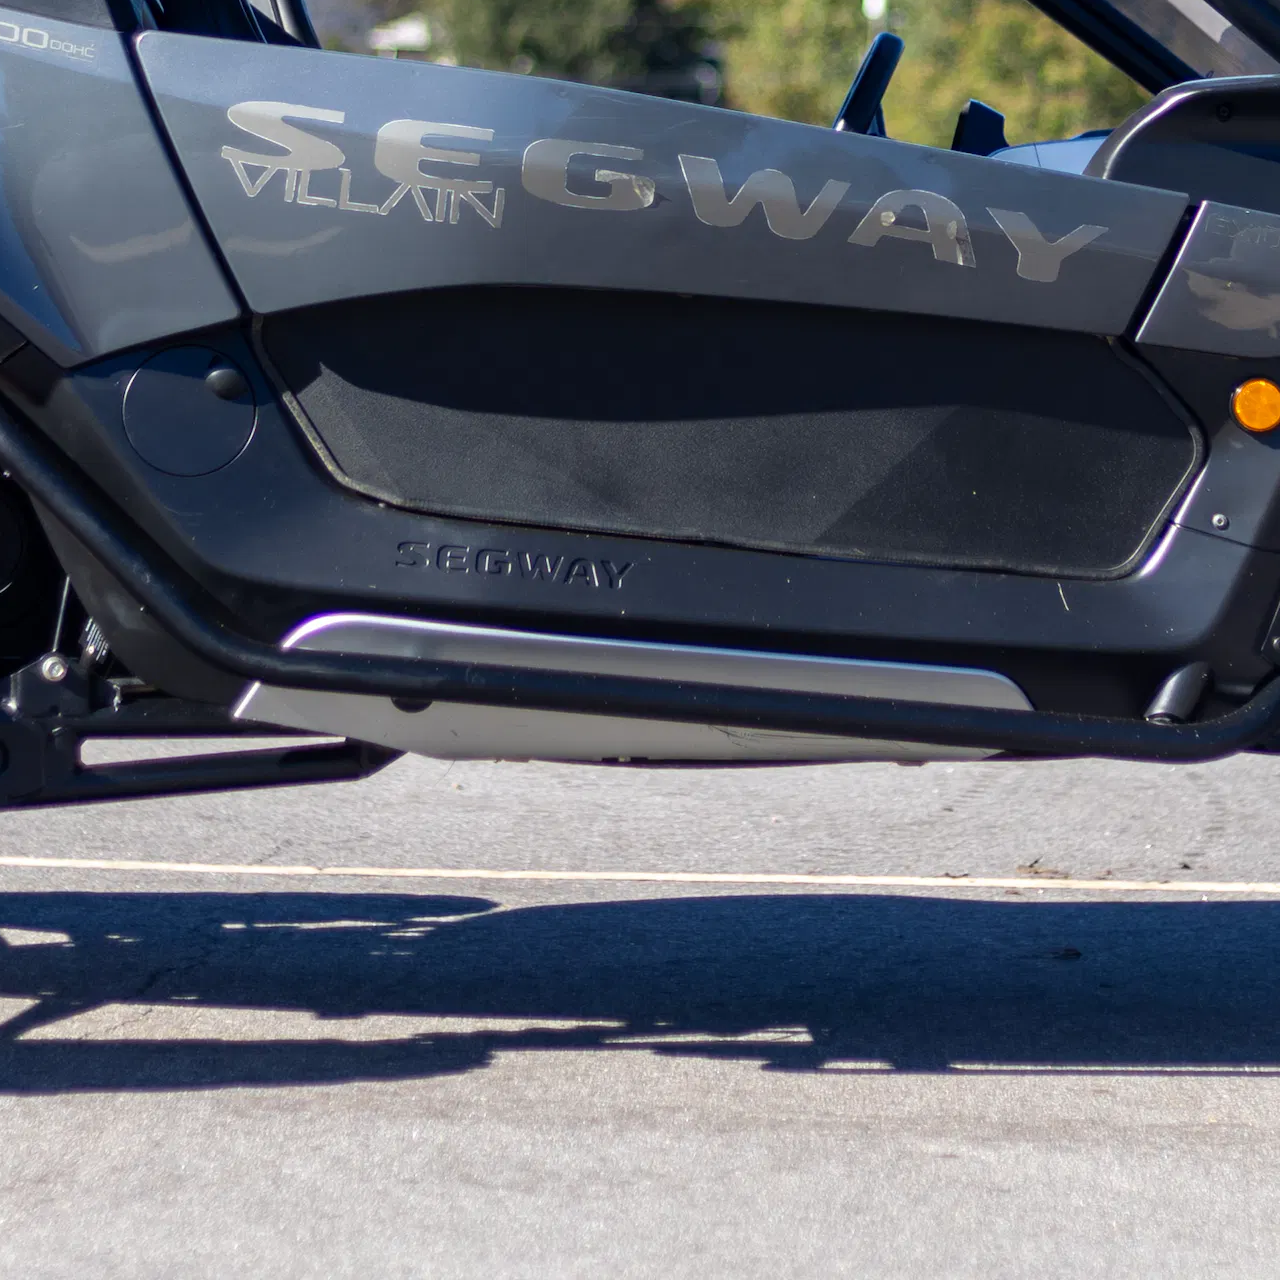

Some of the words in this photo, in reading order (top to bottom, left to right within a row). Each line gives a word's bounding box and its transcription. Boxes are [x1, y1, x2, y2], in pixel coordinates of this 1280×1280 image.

[49, 39, 96, 58] DOHC
[221, 100, 1110, 283] SEGWAY
[227, 157, 506, 229] VILLAIN
[394, 540, 635, 589] SEGWAY
